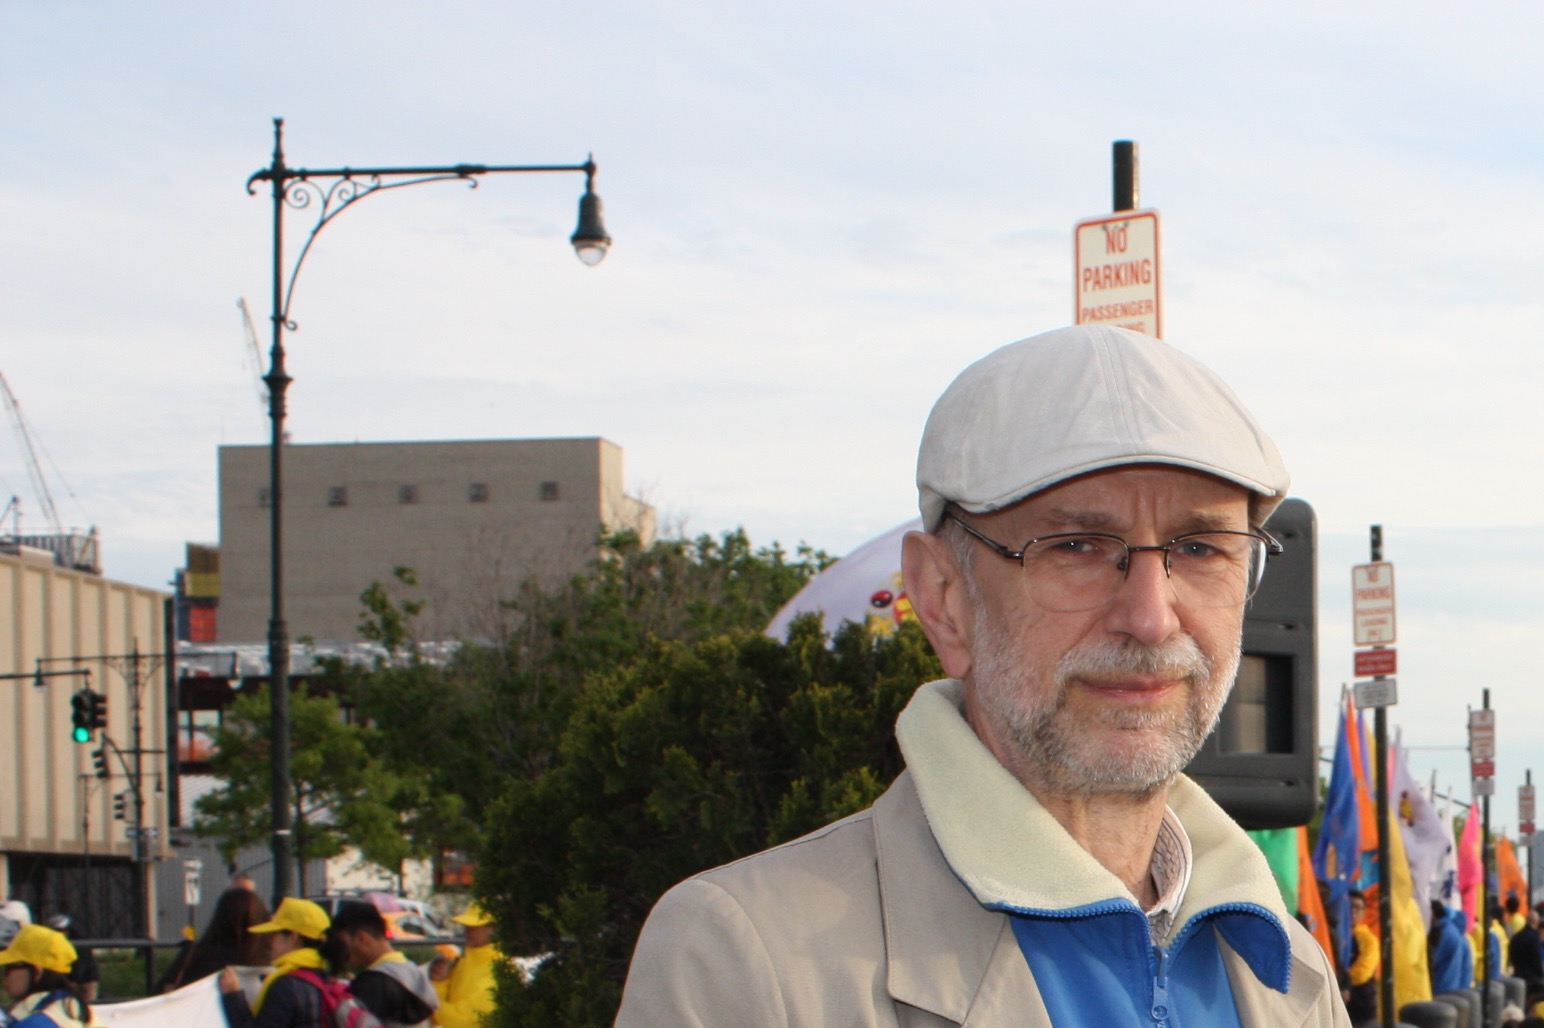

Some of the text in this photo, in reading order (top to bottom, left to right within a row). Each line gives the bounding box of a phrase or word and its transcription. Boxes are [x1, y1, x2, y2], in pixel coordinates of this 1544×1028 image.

[1105, 228, 1127, 253] NO
[1083, 259, 1151, 292] PARKING
[1082, 300, 1153, 322] PASSENGER
